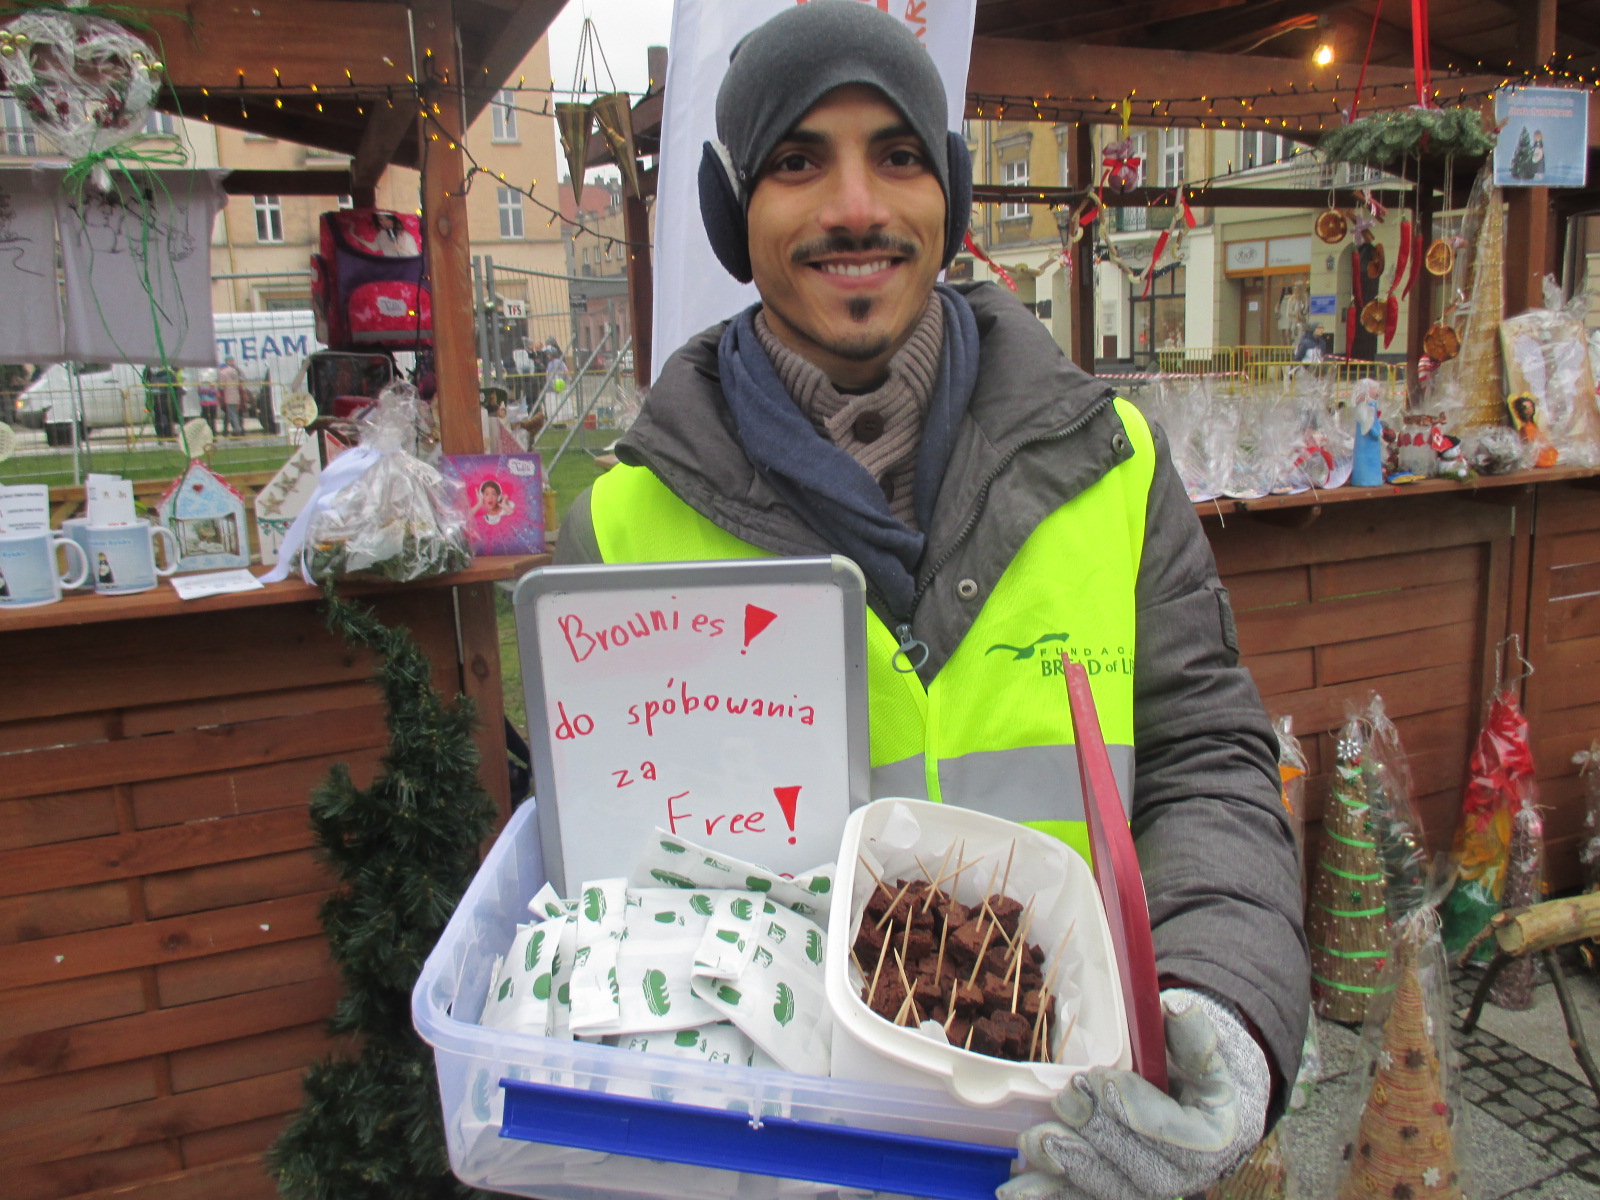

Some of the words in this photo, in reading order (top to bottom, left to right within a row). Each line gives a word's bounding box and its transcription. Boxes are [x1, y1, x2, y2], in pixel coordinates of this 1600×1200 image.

[507, 304, 522, 316] TFS
[216, 335, 308, 360] TEAM
[1041, 659, 1102, 677] BRD
[1105, 660, 1118, 673] of
[555, 701, 595, 740] do
[627, 677, 815, 737] spóbowania
[611, 761, 657, 788] za
